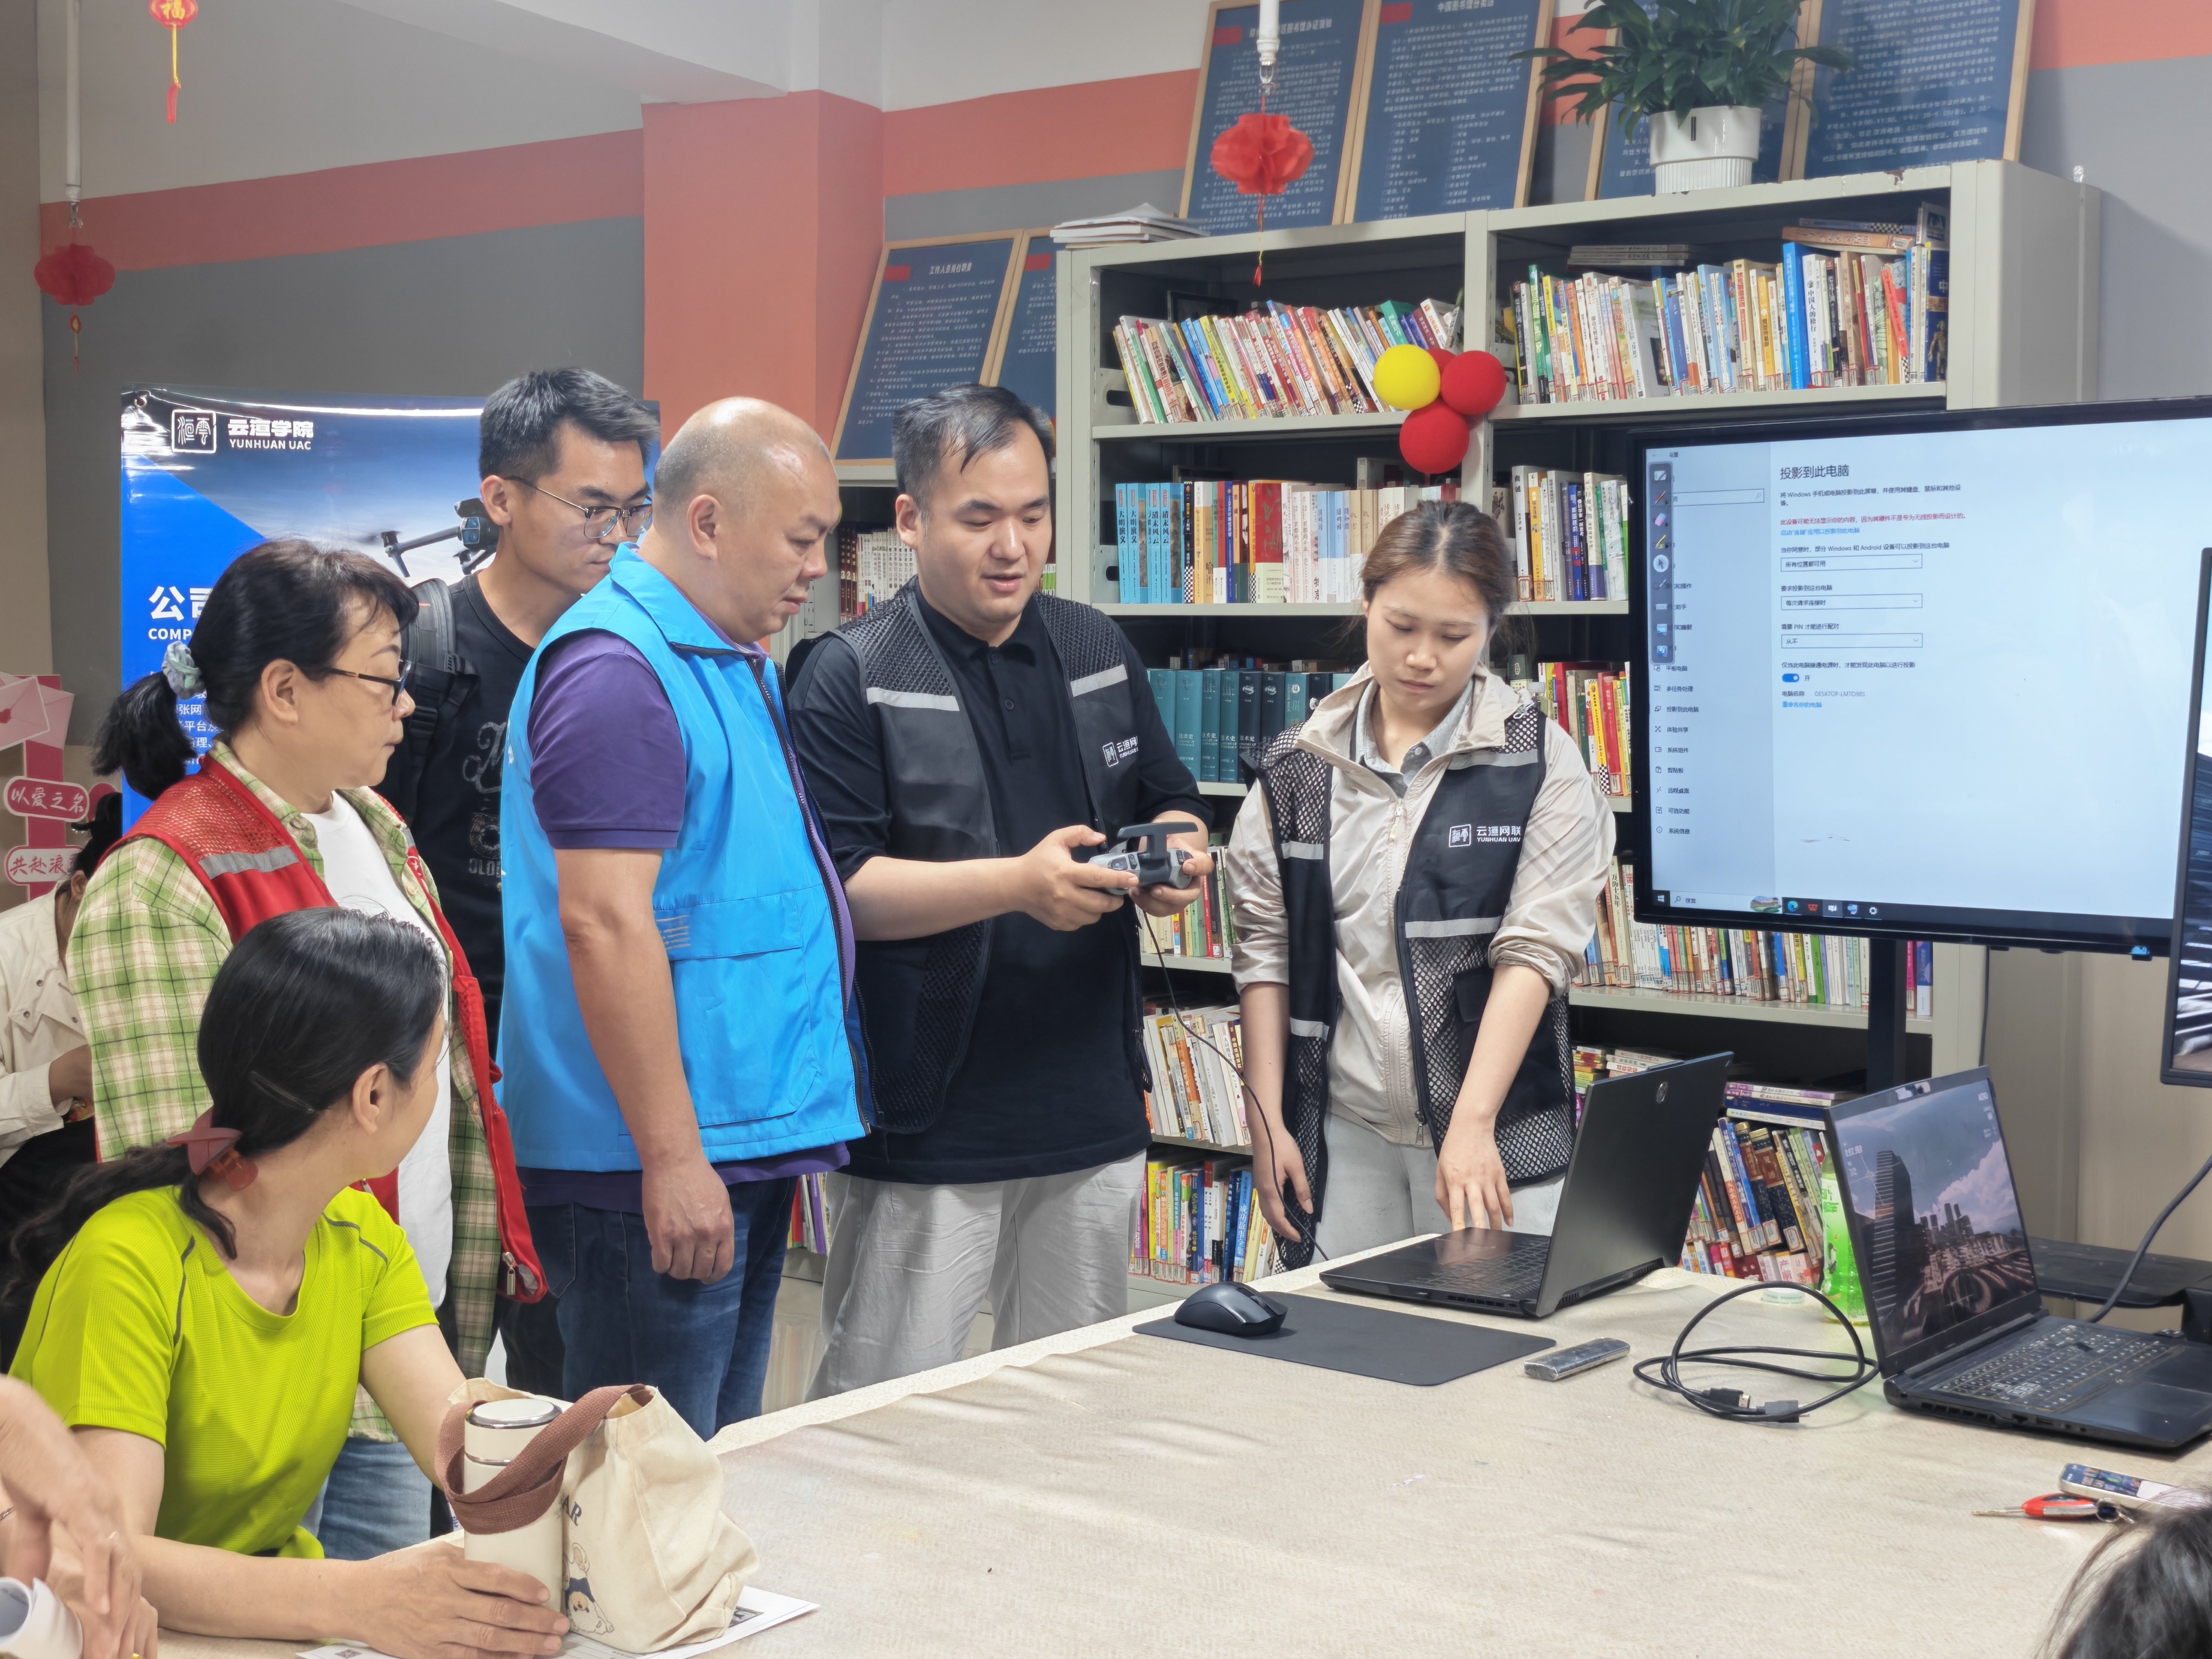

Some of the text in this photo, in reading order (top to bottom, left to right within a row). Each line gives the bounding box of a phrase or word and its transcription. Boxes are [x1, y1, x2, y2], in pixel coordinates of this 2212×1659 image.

[230, 439, 312, 450] YUNHUAN UAC
[1780, 464, 1850, 480] 投影到此电脑
[11, 786, 85, 814] 以爱之名
[1476, 826, 1521, 837] 云洹网联
